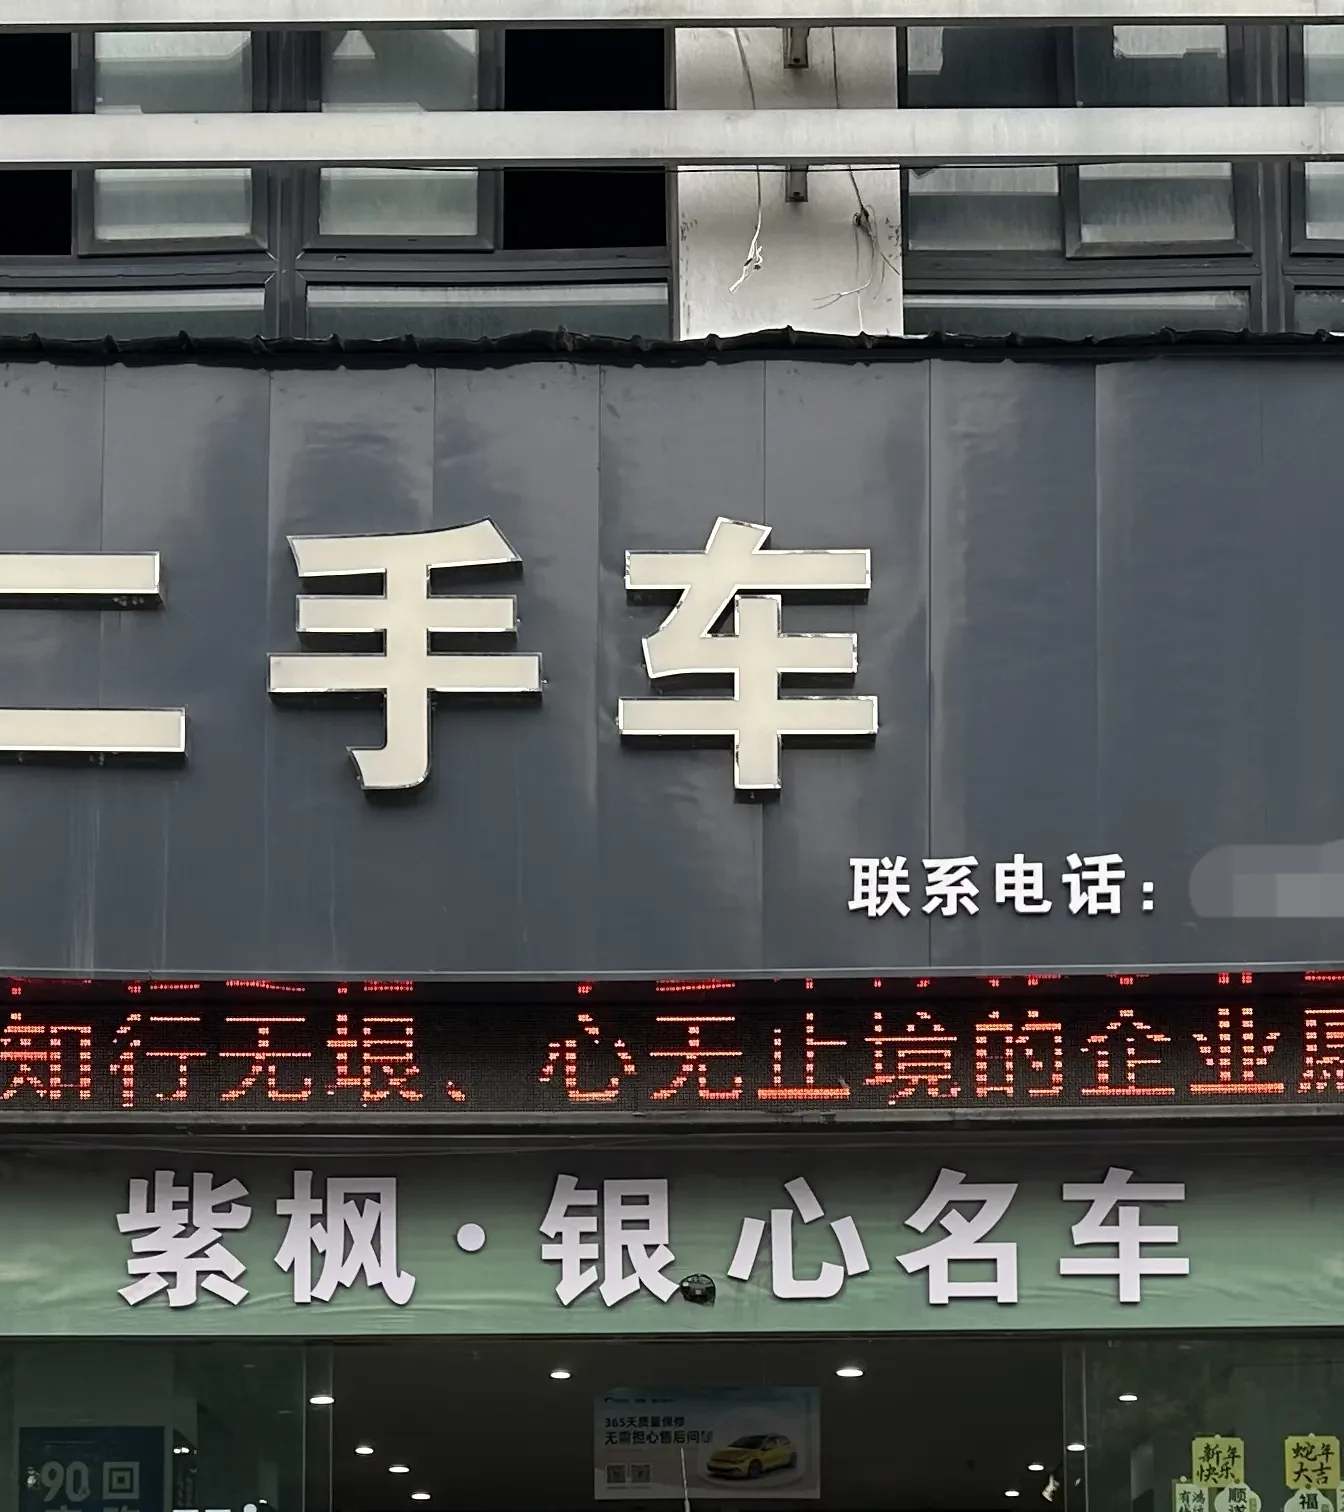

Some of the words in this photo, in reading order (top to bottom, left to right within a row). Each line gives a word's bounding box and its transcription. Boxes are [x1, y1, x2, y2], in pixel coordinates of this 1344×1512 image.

[116, 1168, 1191, 1307] 紫枫·银心名车
